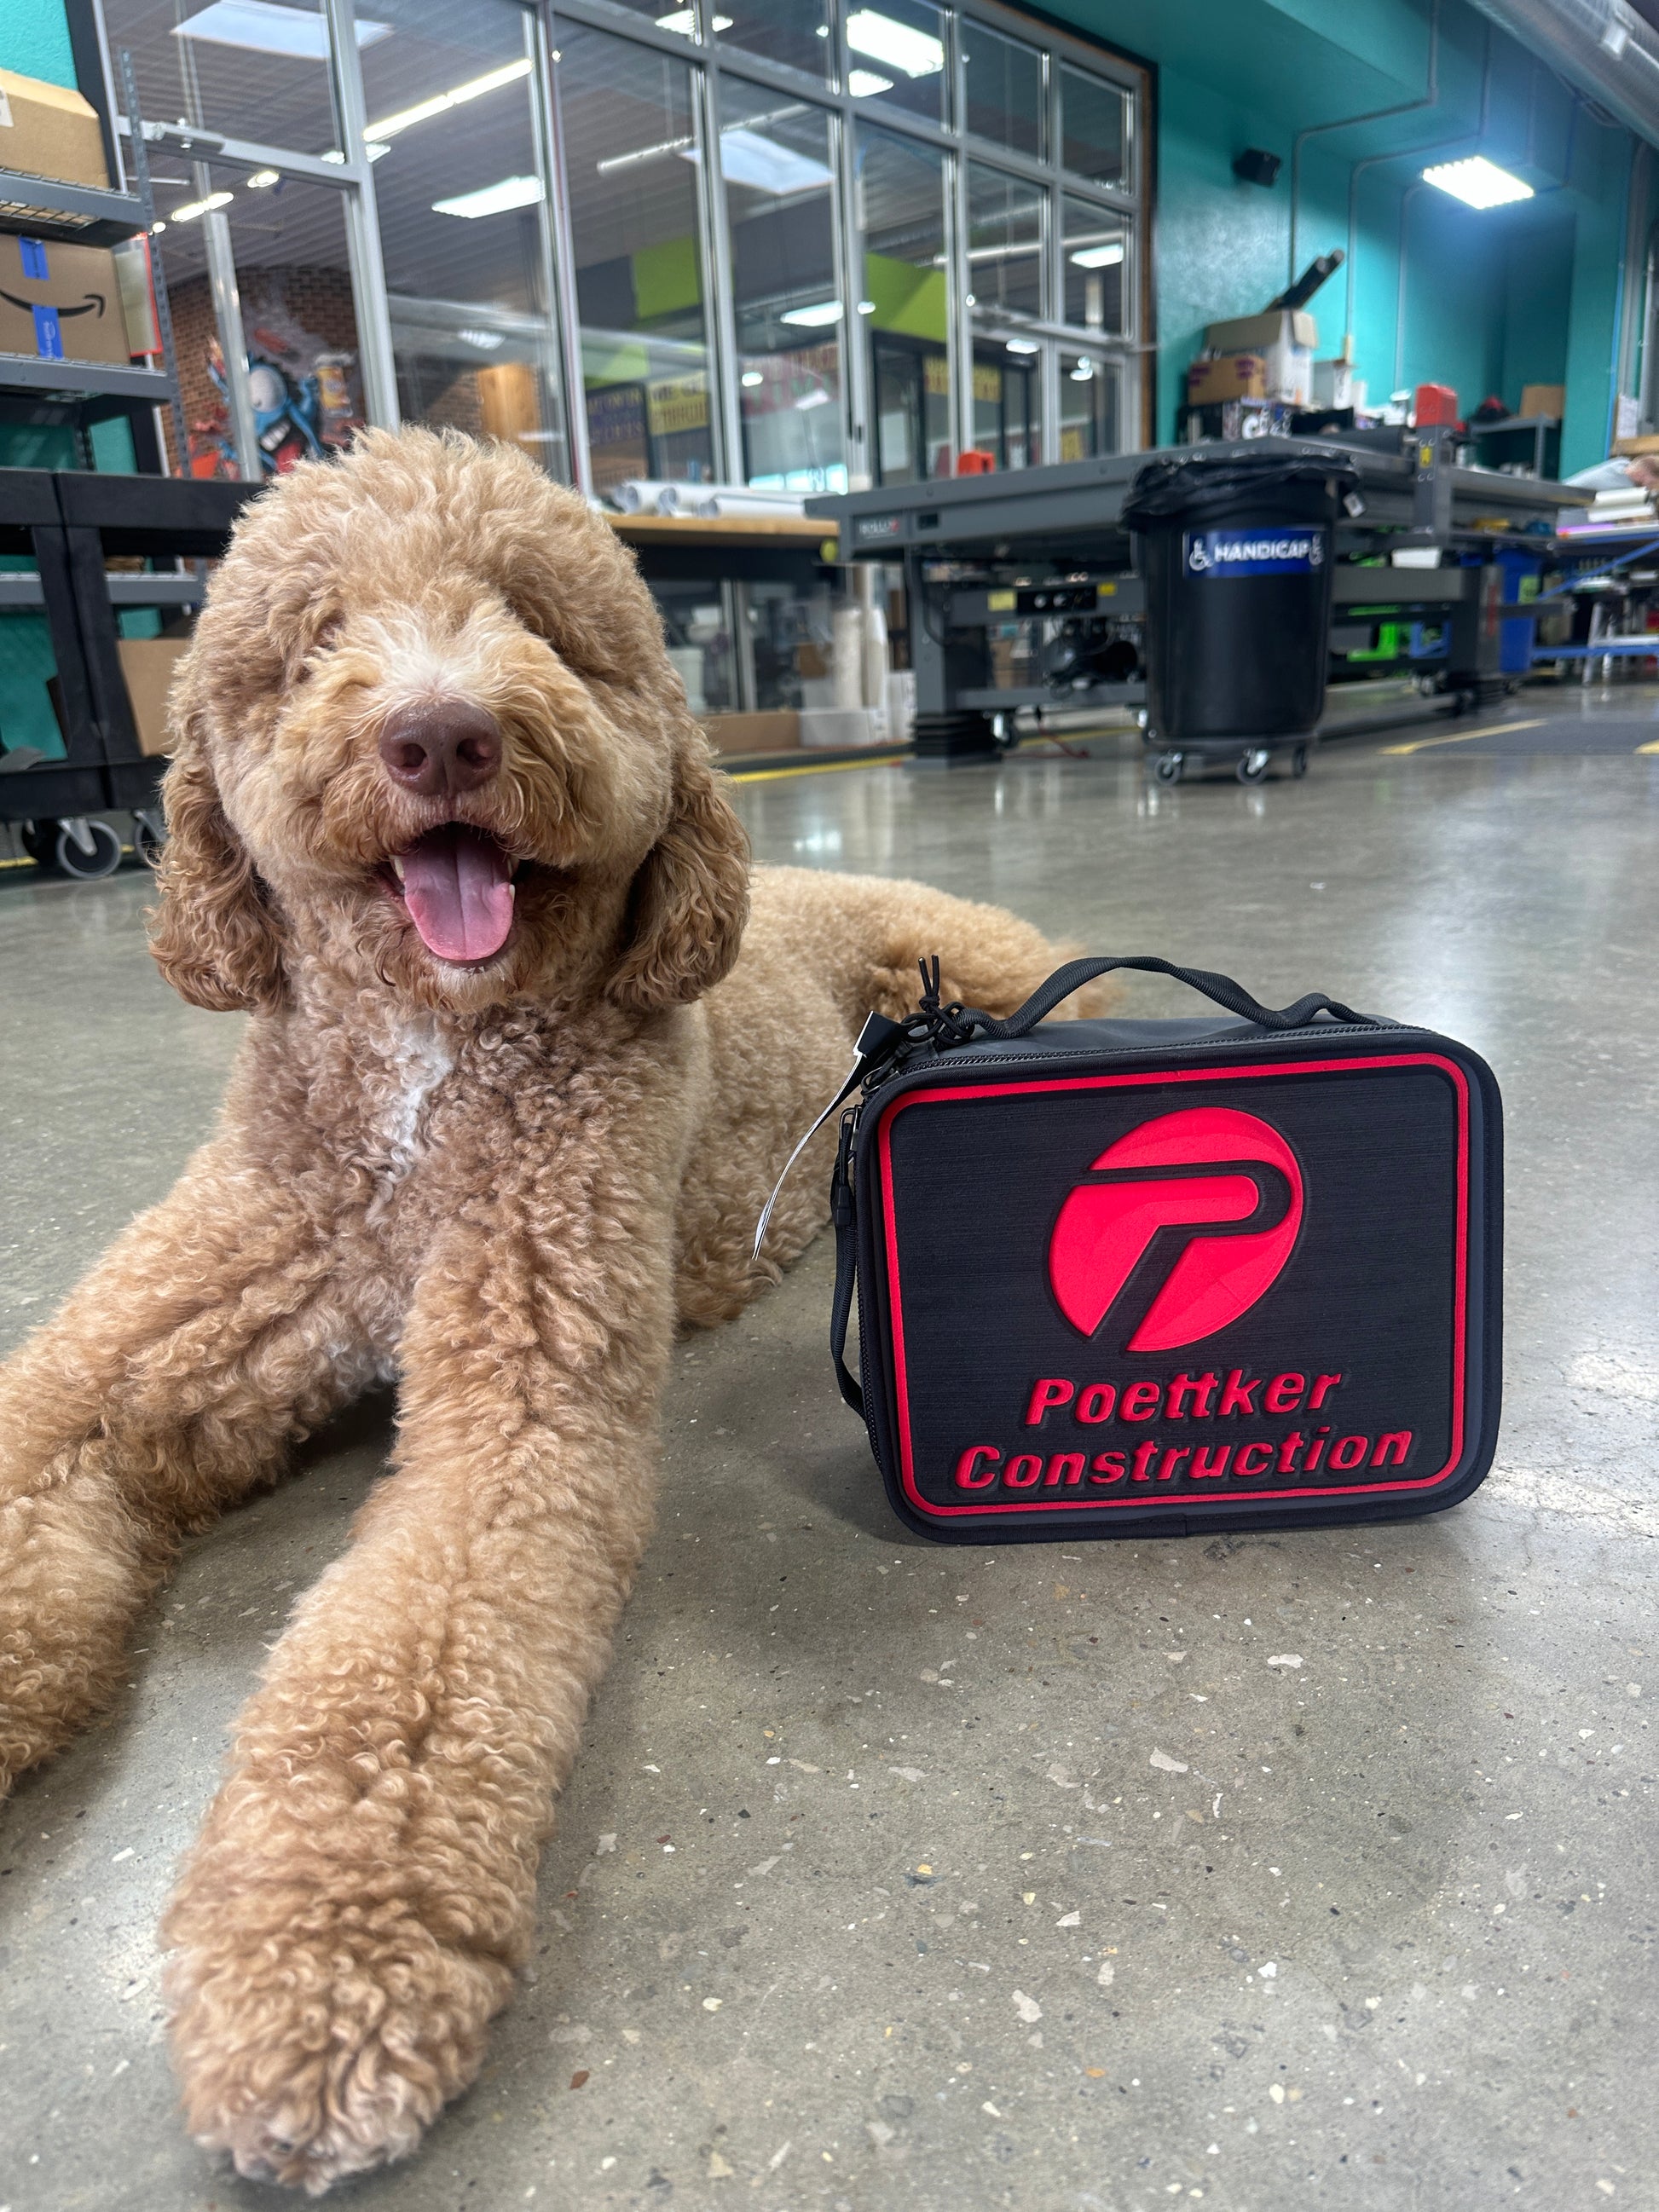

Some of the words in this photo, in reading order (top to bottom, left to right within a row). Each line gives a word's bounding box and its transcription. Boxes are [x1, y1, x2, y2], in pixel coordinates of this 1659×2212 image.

[1214, 539, 1310, 563] HANDICAP
[1026, 1369, 1342, 1425] Poettker
[956, 1427, 1413, 1489] Construction
